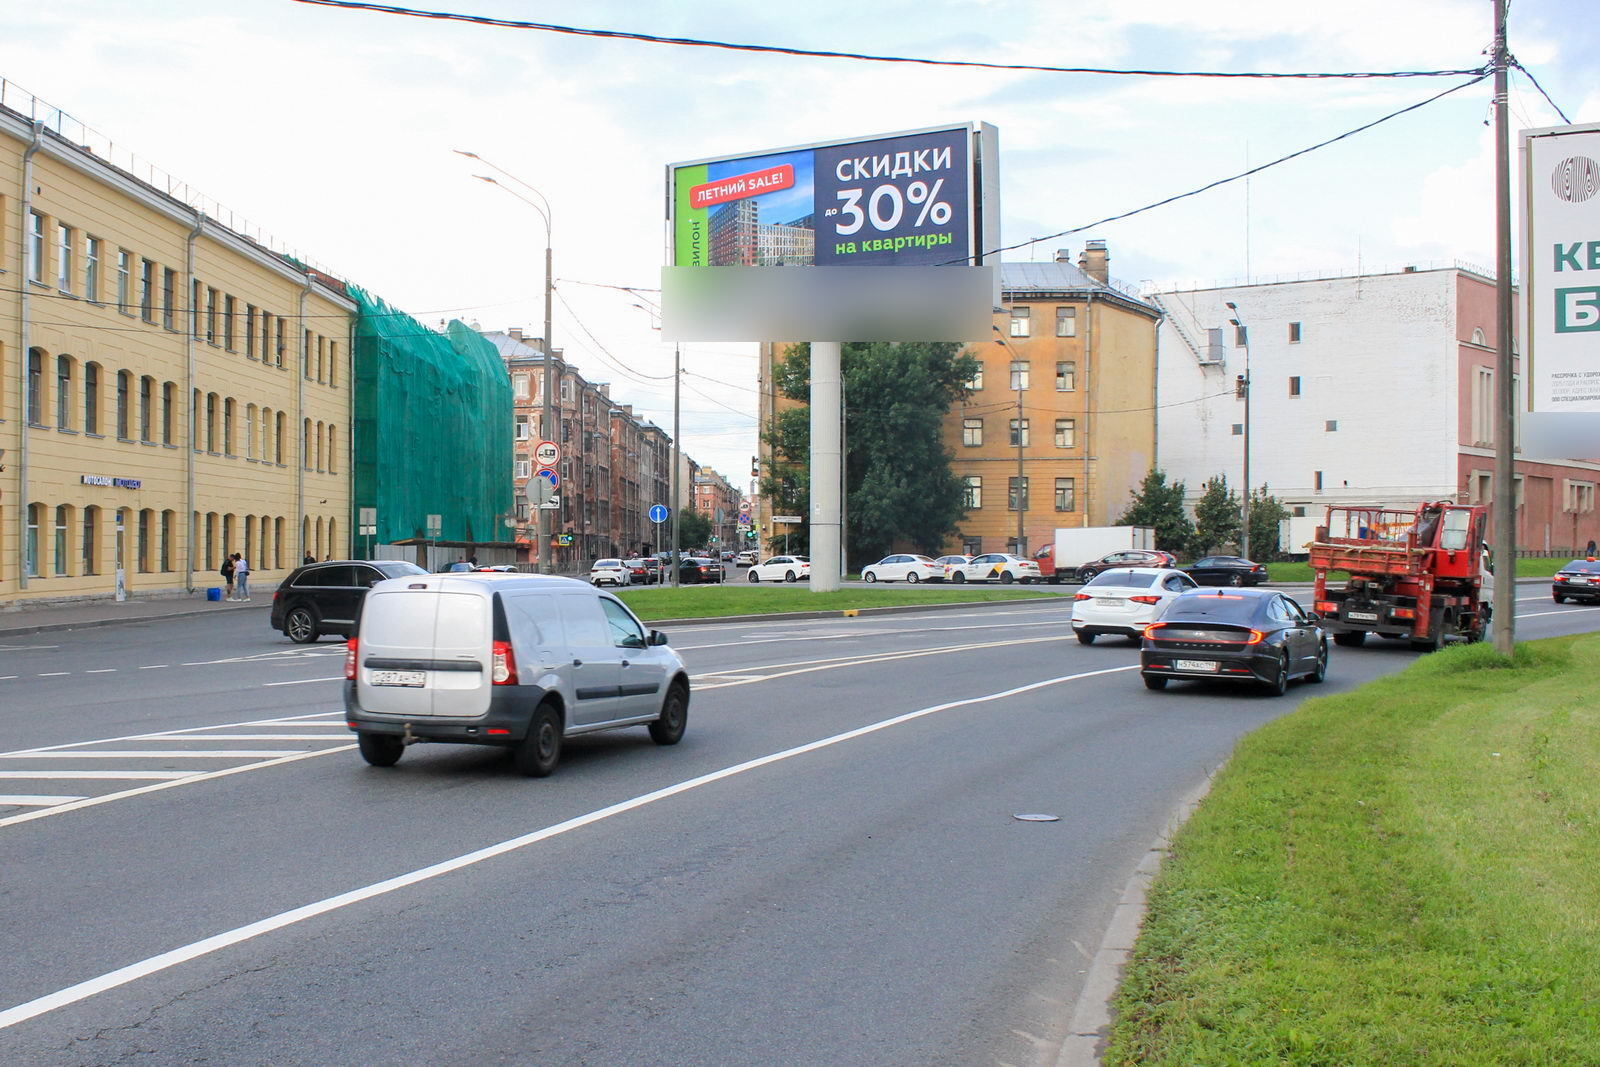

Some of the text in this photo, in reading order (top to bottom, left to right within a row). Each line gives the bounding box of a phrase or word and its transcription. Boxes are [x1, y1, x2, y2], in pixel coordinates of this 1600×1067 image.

[836, 146, 951, 181] СКИДКИ
[697, 172, 783, 202] ЛЕТНИЙ SALE!
[825, 178, 952, 236] до 30%
[836, 232, 952, 255] на квартиры
